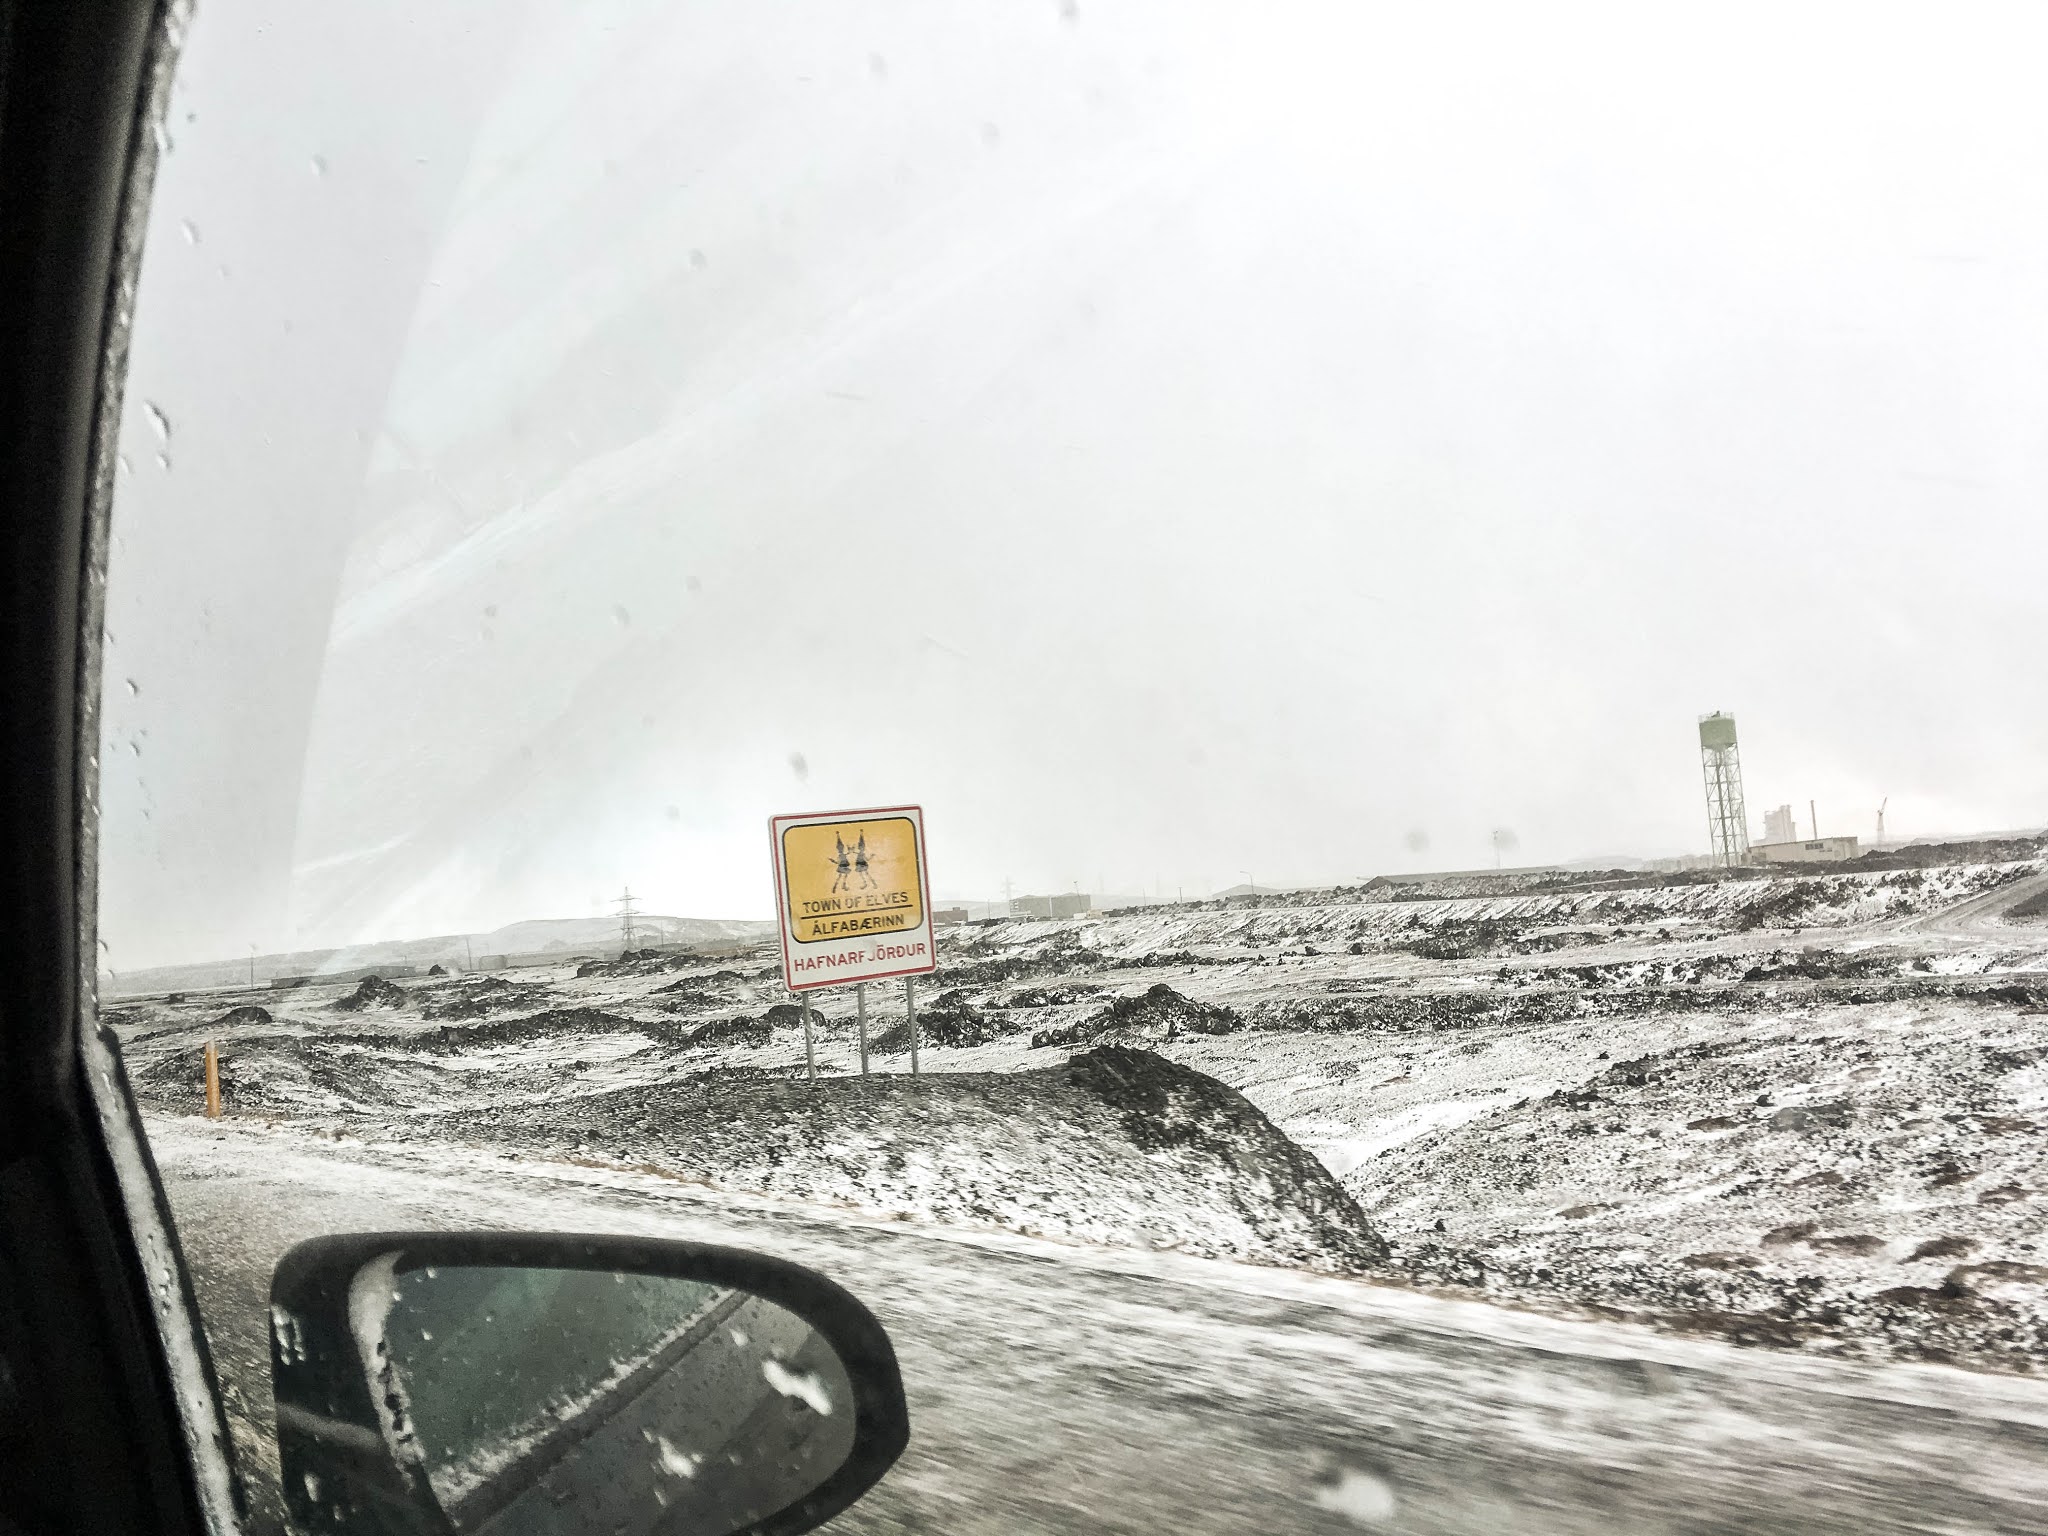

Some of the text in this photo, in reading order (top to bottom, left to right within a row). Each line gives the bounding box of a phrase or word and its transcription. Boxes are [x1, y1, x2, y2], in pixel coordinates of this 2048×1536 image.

[803, 892, 908, 914] TOWN OF ELVES
[812, 914, 904, 936] ÁLFABÆRINN
[794, 943, 926, 972] HAFNARFJÖRÐUR
